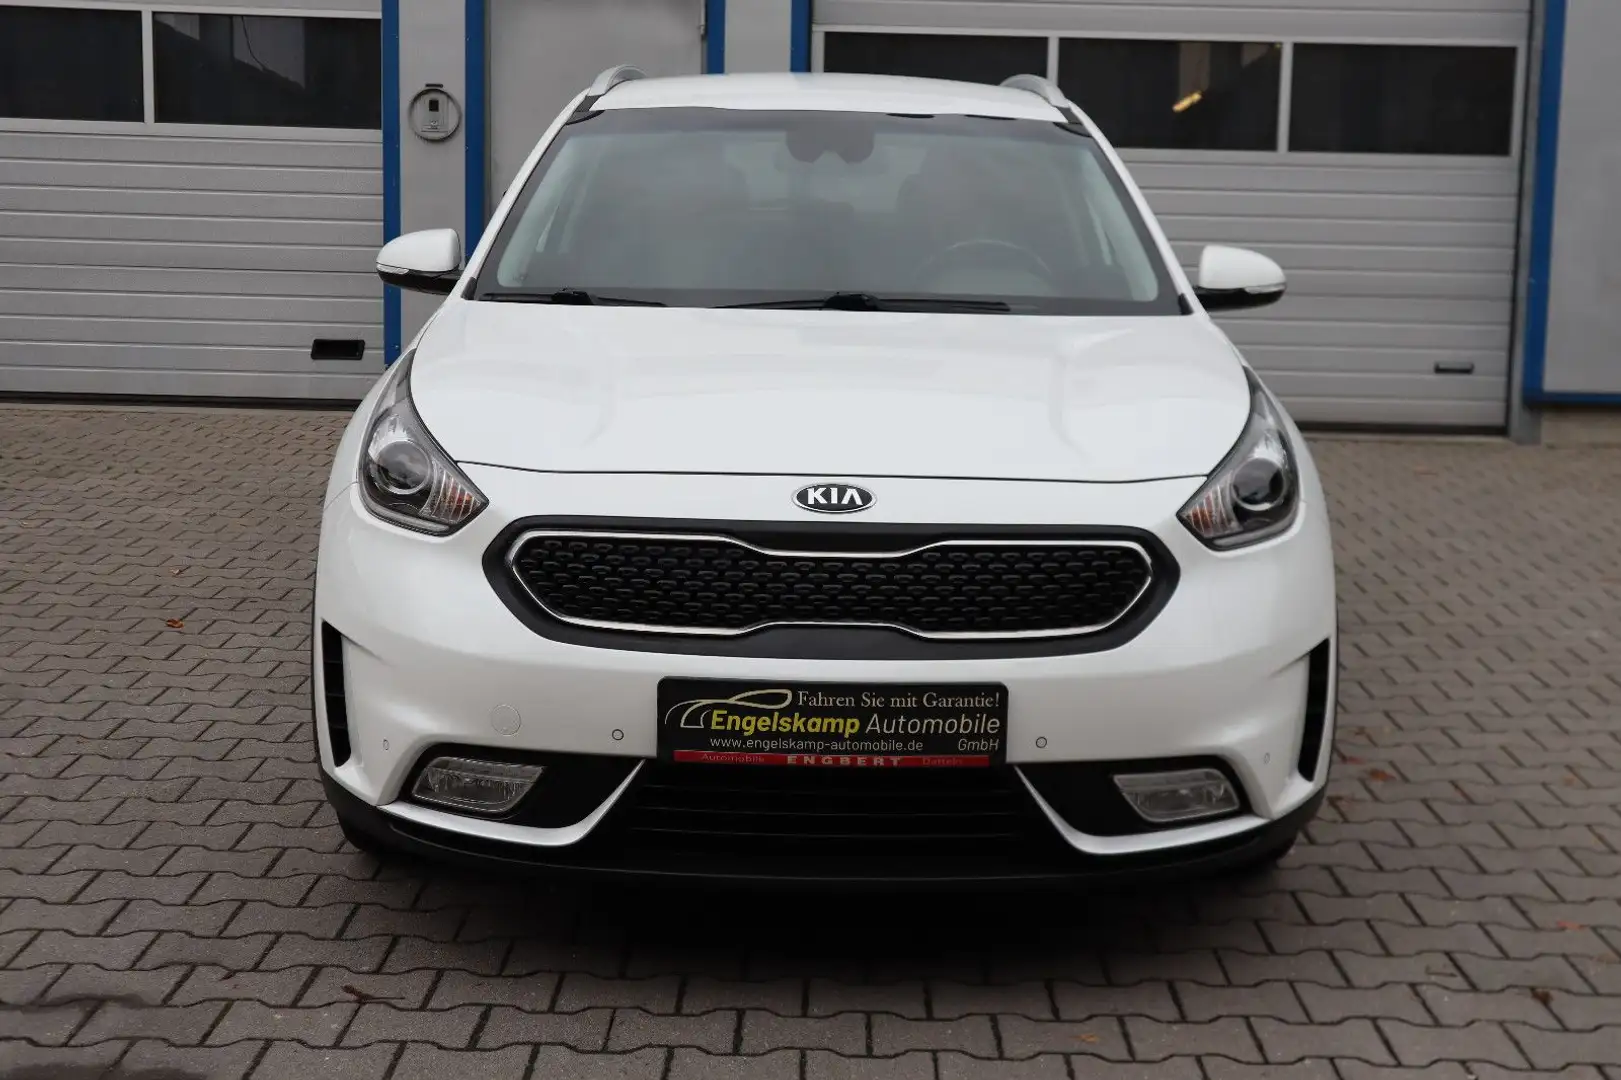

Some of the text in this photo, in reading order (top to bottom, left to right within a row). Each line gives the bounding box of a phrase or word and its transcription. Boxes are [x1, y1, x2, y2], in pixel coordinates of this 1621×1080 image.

[806, 487, 864, 505] KIA
[797, 690, 1000, 708] Fahren Sie mit Garantie!
[710, 709, 1000, 738] Engelskamp Automobile
[710, 737, 999, 752] www.engelskamp-automobile.de GmbH
[786, 755, 903, 766] ENGBERT
